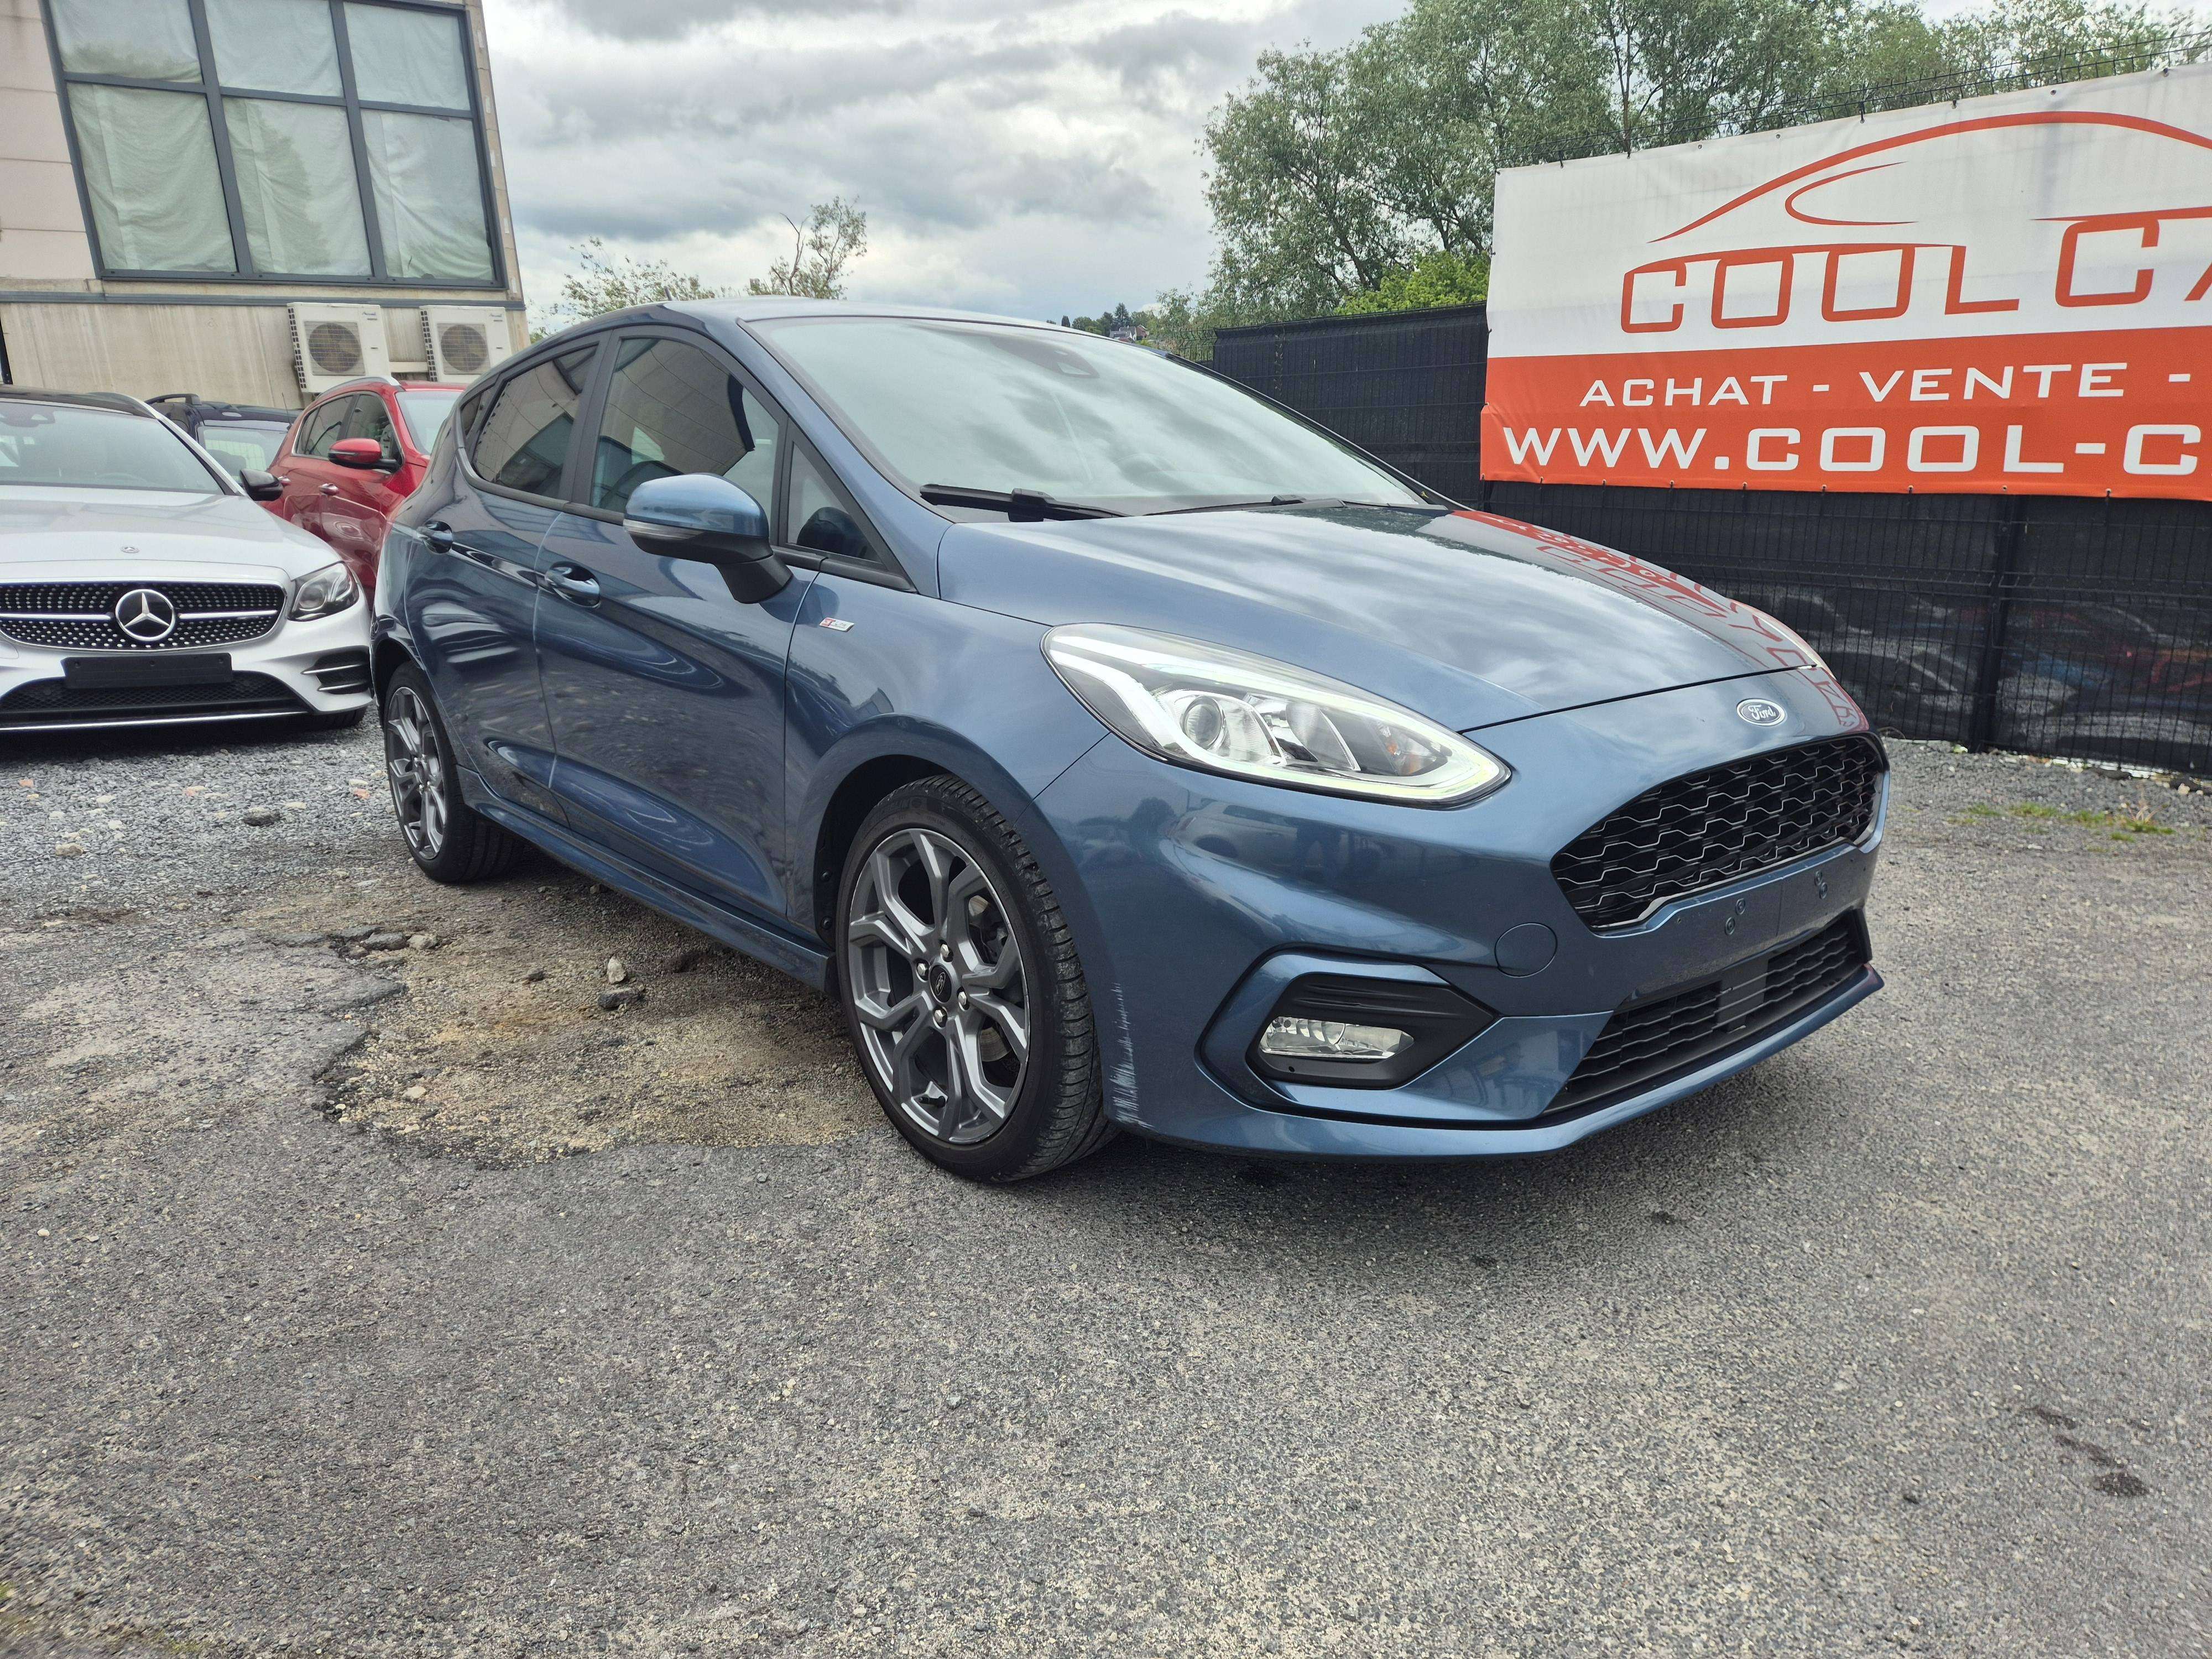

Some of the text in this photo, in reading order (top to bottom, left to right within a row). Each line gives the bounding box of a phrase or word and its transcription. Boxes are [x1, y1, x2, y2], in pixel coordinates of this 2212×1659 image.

[1621, 243, 2020, 333] COOL
[1579, 375, 1788, 407] ACHAT
[1859, 362, 2128, 402] VENTE
[1503, 424, 2212, 476] WWW.COOL-C
[1747, 704, 1776, 721] Ford
